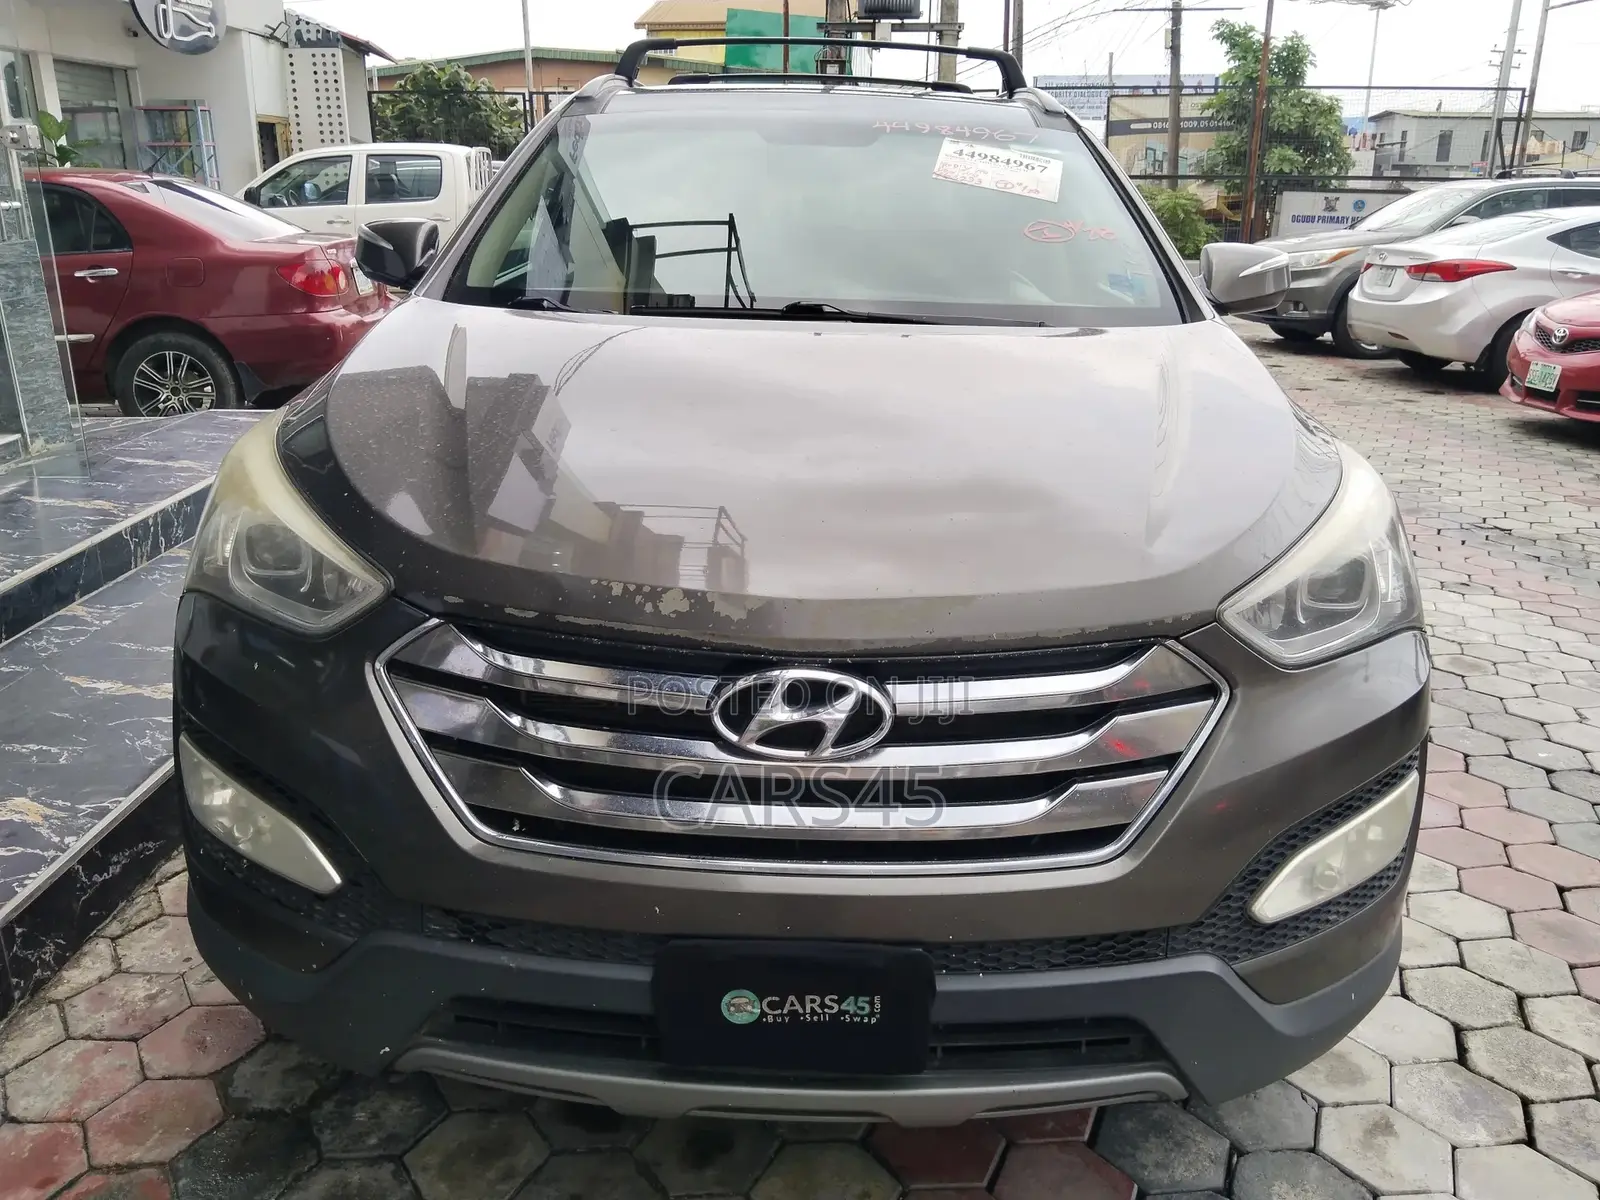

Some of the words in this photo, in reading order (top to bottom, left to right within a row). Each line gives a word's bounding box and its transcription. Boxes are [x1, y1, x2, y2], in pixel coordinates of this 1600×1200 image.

[872, 120, 1040, 144] 44984967
[952, 148, 1049, 174] 44984967
[1291, 214, 1316, 224] OGUDU
[1316, 215, 1350, 225] PRIMARY
[761, 994, 871, 1015] CARS45
